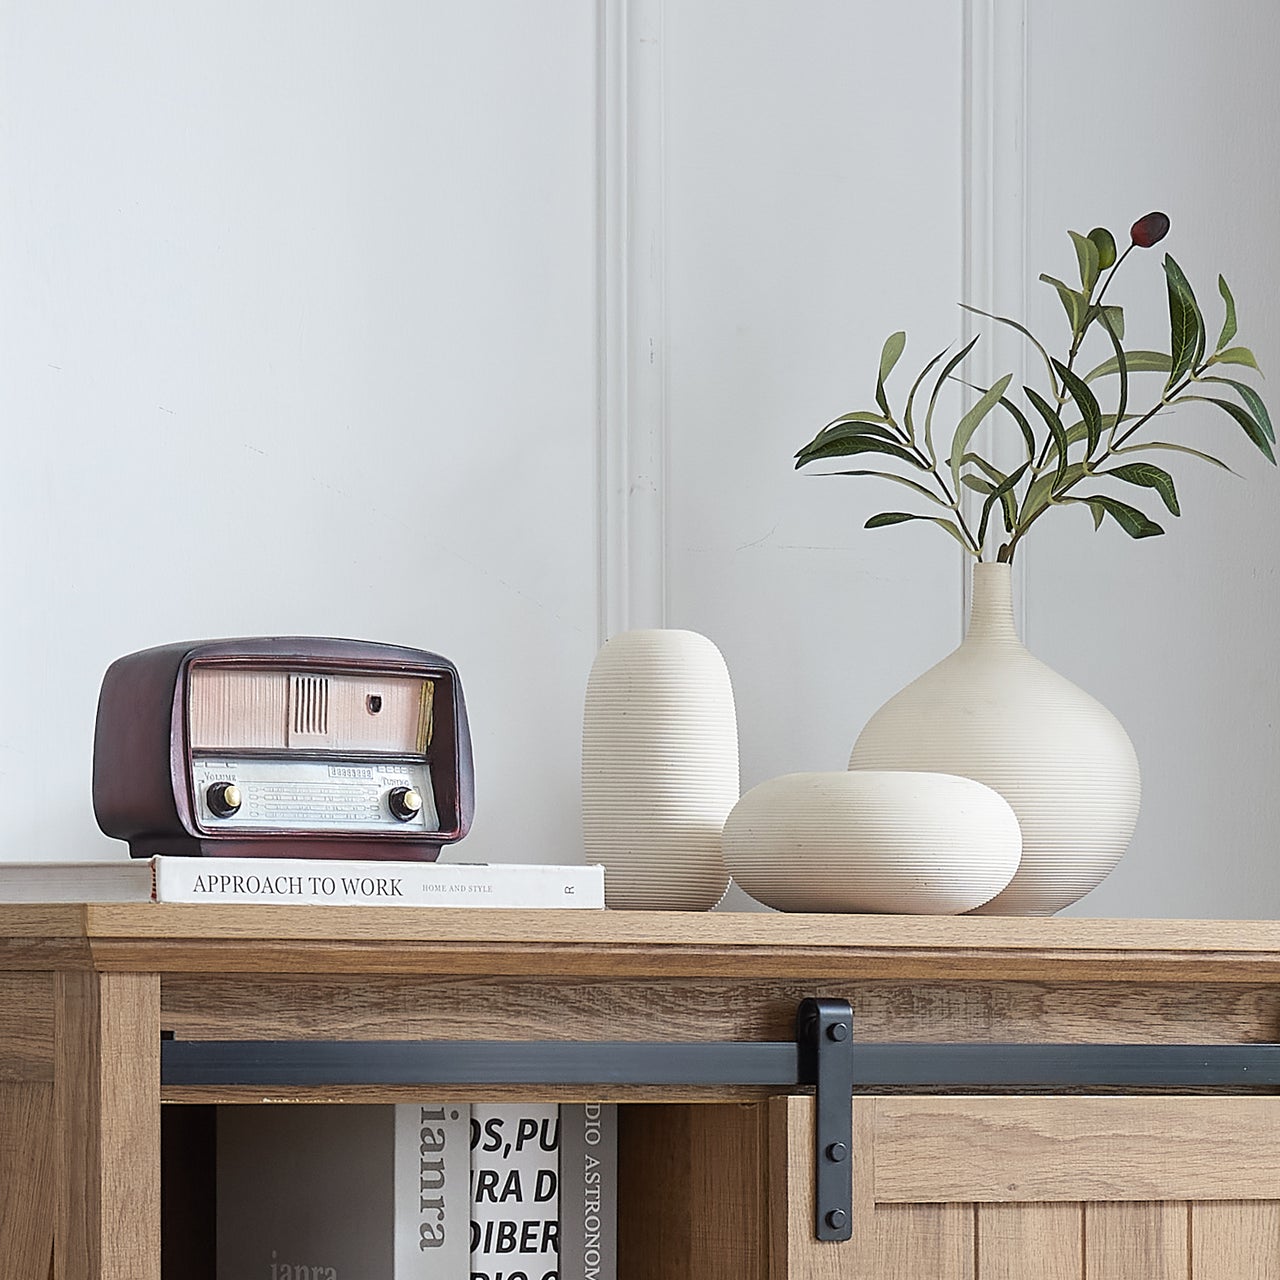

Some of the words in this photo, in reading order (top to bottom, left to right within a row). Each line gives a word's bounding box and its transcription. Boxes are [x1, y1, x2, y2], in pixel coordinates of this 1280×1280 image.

[192, 874, 303, 894] APPROACH
[308, 877, 336, 896] TO
[341, 877, 404, 897] WORK
[422, 884, 447, 893] HOME
[449, 884, 466, 893] AND
[468, 885, 493, 894] STYLE
[565, 886, 575, 895] R
[420, 1106, 459, 1252] ianra
[470, 1169, 523, 1203] RA
